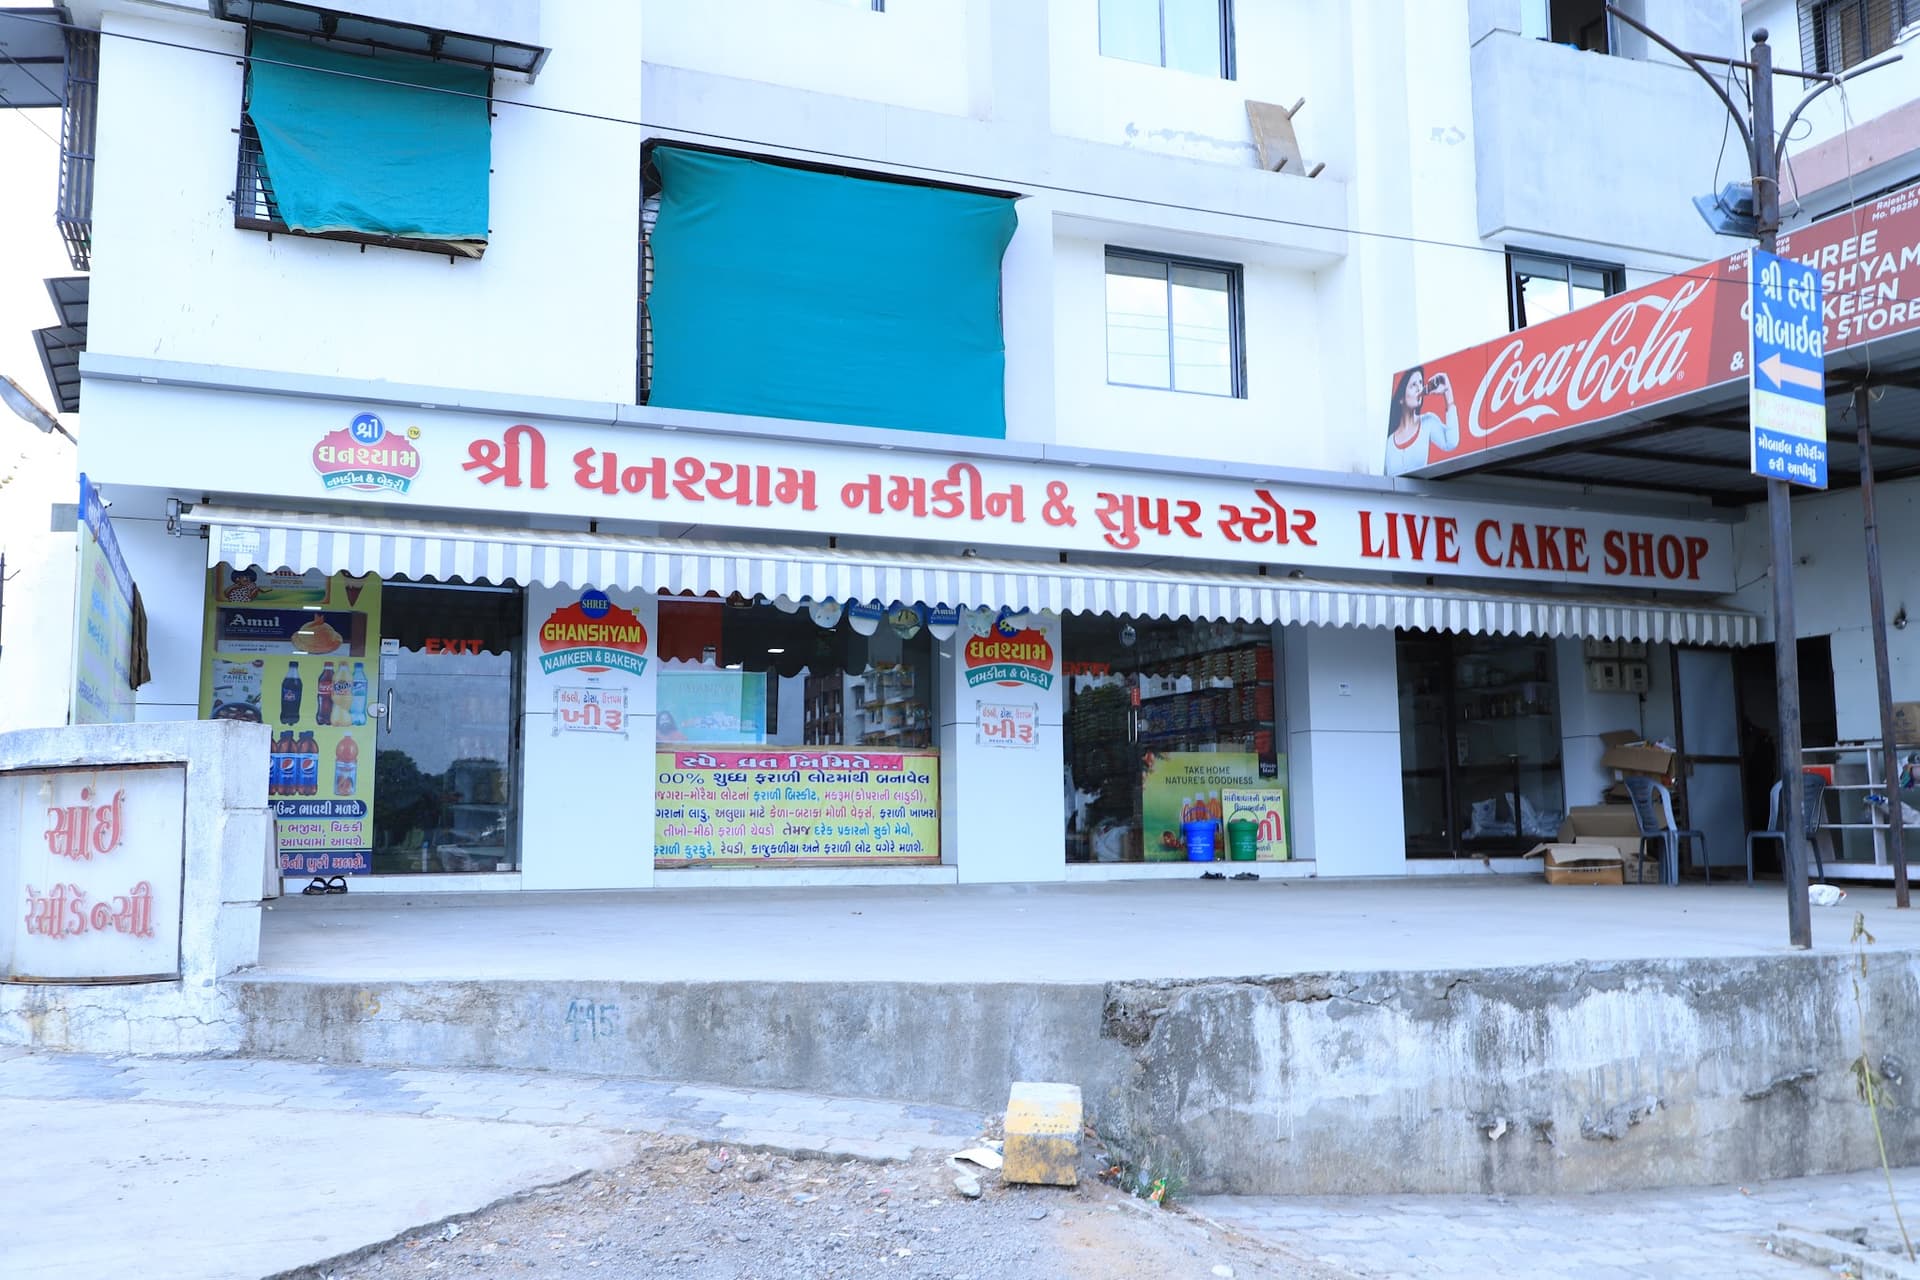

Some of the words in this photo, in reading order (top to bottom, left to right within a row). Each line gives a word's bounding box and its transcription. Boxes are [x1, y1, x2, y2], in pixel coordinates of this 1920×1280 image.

[1790, 229, 1879, 270] HREE
[1760, 260, 1782, 302] શ્રી
[1788, 271, 1816, 312] હરી
[1836, 296, 1920, 341] STORE
[1468, 271, 1714, 438] Coca-Cola
[356, 418, 379, 439] શ્રી
[318, 446, 417, 468] ઘનશ્યામ
[327, 472, 364, 487] નમકીન
[366, 473, 375, 483] &
[377, 474, 405, 491] બેકરી
[462, 424, 549, 489] શ્રી
[573, 447, 819, 511] ઘનશ્યામ
[841, 462, 1026, 523] નમકીન
[1042, 480, 1078, 527] &
[1095, 490, 1203, 550] સુપર
[1217, 489, 1318, 546] સ્ટોર
[1358, 511, 1461, 564] LIVE
[1474, 519, 1590, 573] CAKE
[1604, 530, 1709, 580] SHOP
[582, 599, 609, 610] SHREE
[229, 614, 281, 627] Amul
[544, 623, 641, 643] GHANSHYAM
[425, 637, 484, 656] EXIT
[970, 641, 1047, 660] ઘનશ્યામ
[545, 651, 593, 672] NAMKEEN
[595, 651, 602, 661] &
[604, 651, 644, 673] BAKERY
[969, 665, 1007, 685] નમકીન
[1010, 669, 1017, 678] &
[1020, 667, 1048, 688] બેકરી
[659, 773, 705, 784] 00%
[755, 770, 800, 785] ફરાળી
[808, 769, 869, 783] લોટમાંથી
[876, 771, 930, 784] બનાવેલ
[1184, 766, 1205, 775] TAKE
[1206, 766, 1231, 775] HOME
[1165, 776, 1206, 785] NATURE'S
[1208, 776, 1254, 785] GOODNESS
[654, 787, 716, 801] જગરા-મોરૈયા
[299, 801, 332, 815] ભાવથી
[749, 806, 765, 818] માટે
[751, 823, 774, 836] ચેવડો
[782, 822, 810, 836] તેમજ
[814, 822, 833, 836] દરેક
[802, 840, 820, 853] અને
[855, 840, 871, 854] લોટ
